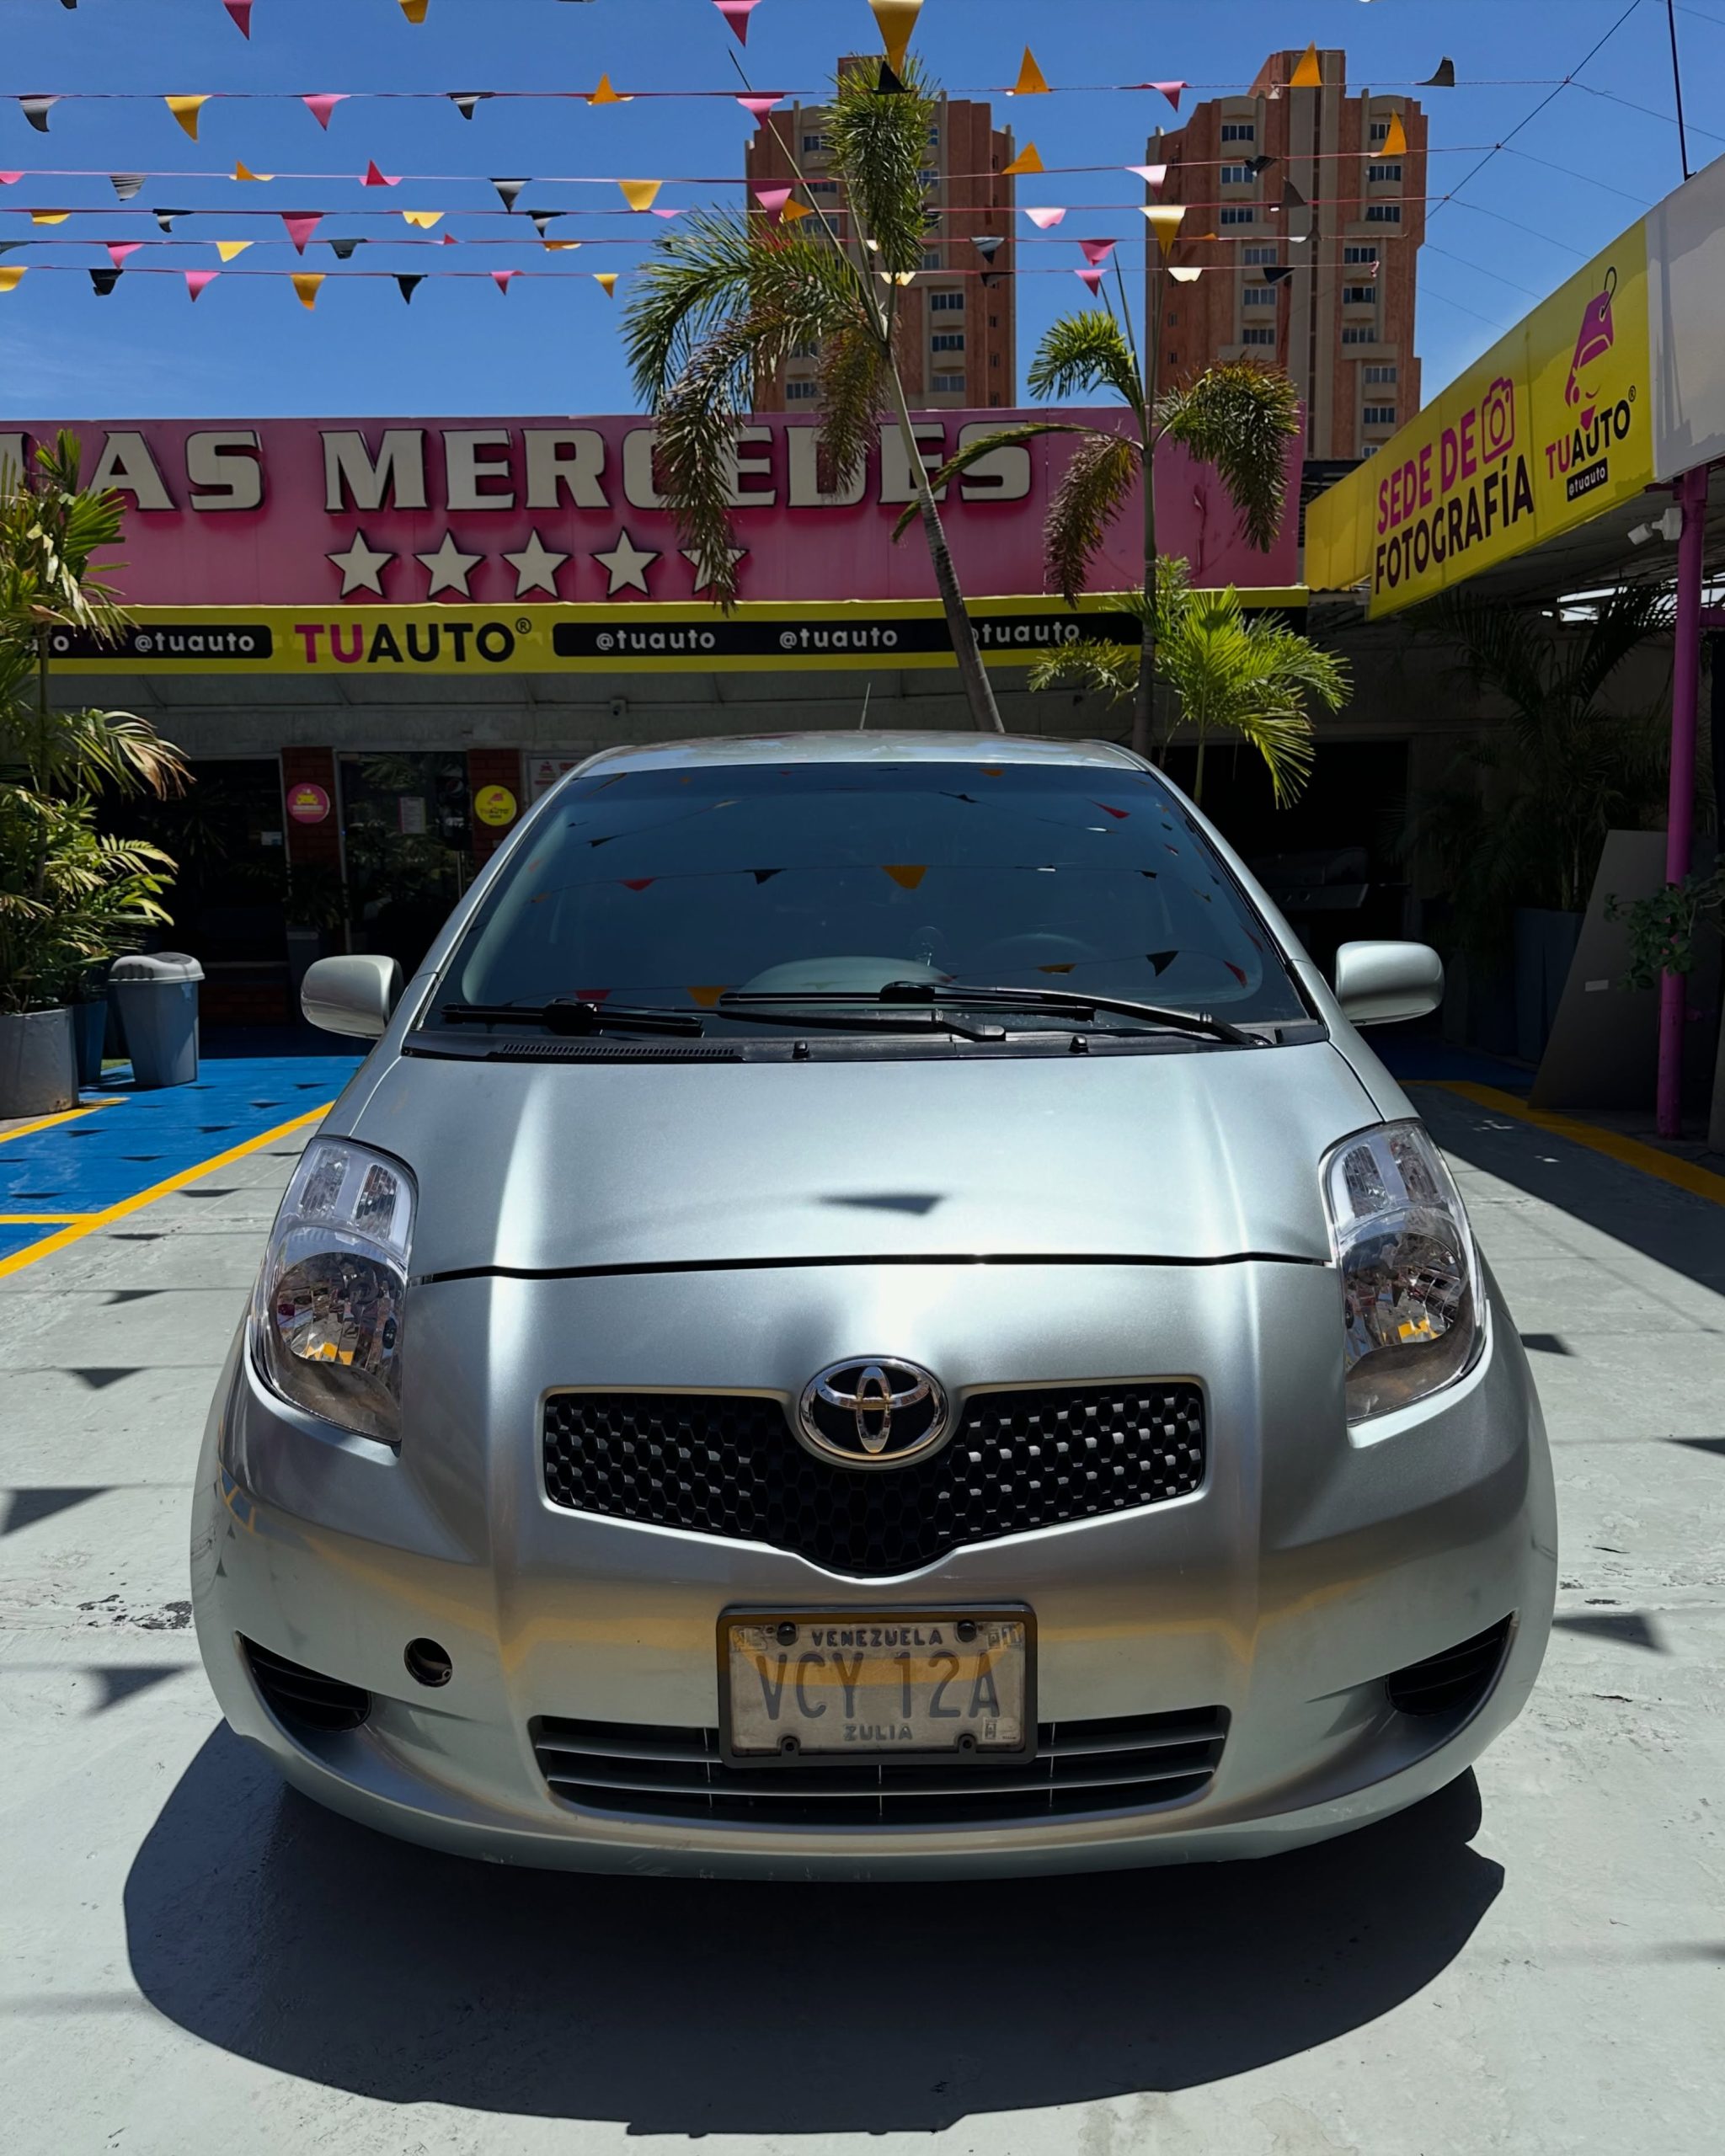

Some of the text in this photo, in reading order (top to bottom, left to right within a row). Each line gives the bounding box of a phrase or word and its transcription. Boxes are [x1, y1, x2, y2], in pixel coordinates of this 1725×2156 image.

[1377, 408, 1477, 535] SEDE DE
[1568, 466, 1606, 496] @tuauto
[1375, 455, 1535, 595] FOTOGRAFÍA
[135, 632, 255, 652] @tuauto
[595, 628, 716, 651] @tuauto
[779, 626, 899, 649] @tuauto
[811, 1628, 943, 1646] VENEZUELA
[756, 1652, 1000, 1720] VCY 12A
[844, 1724, 913, 1741] ZULIA
